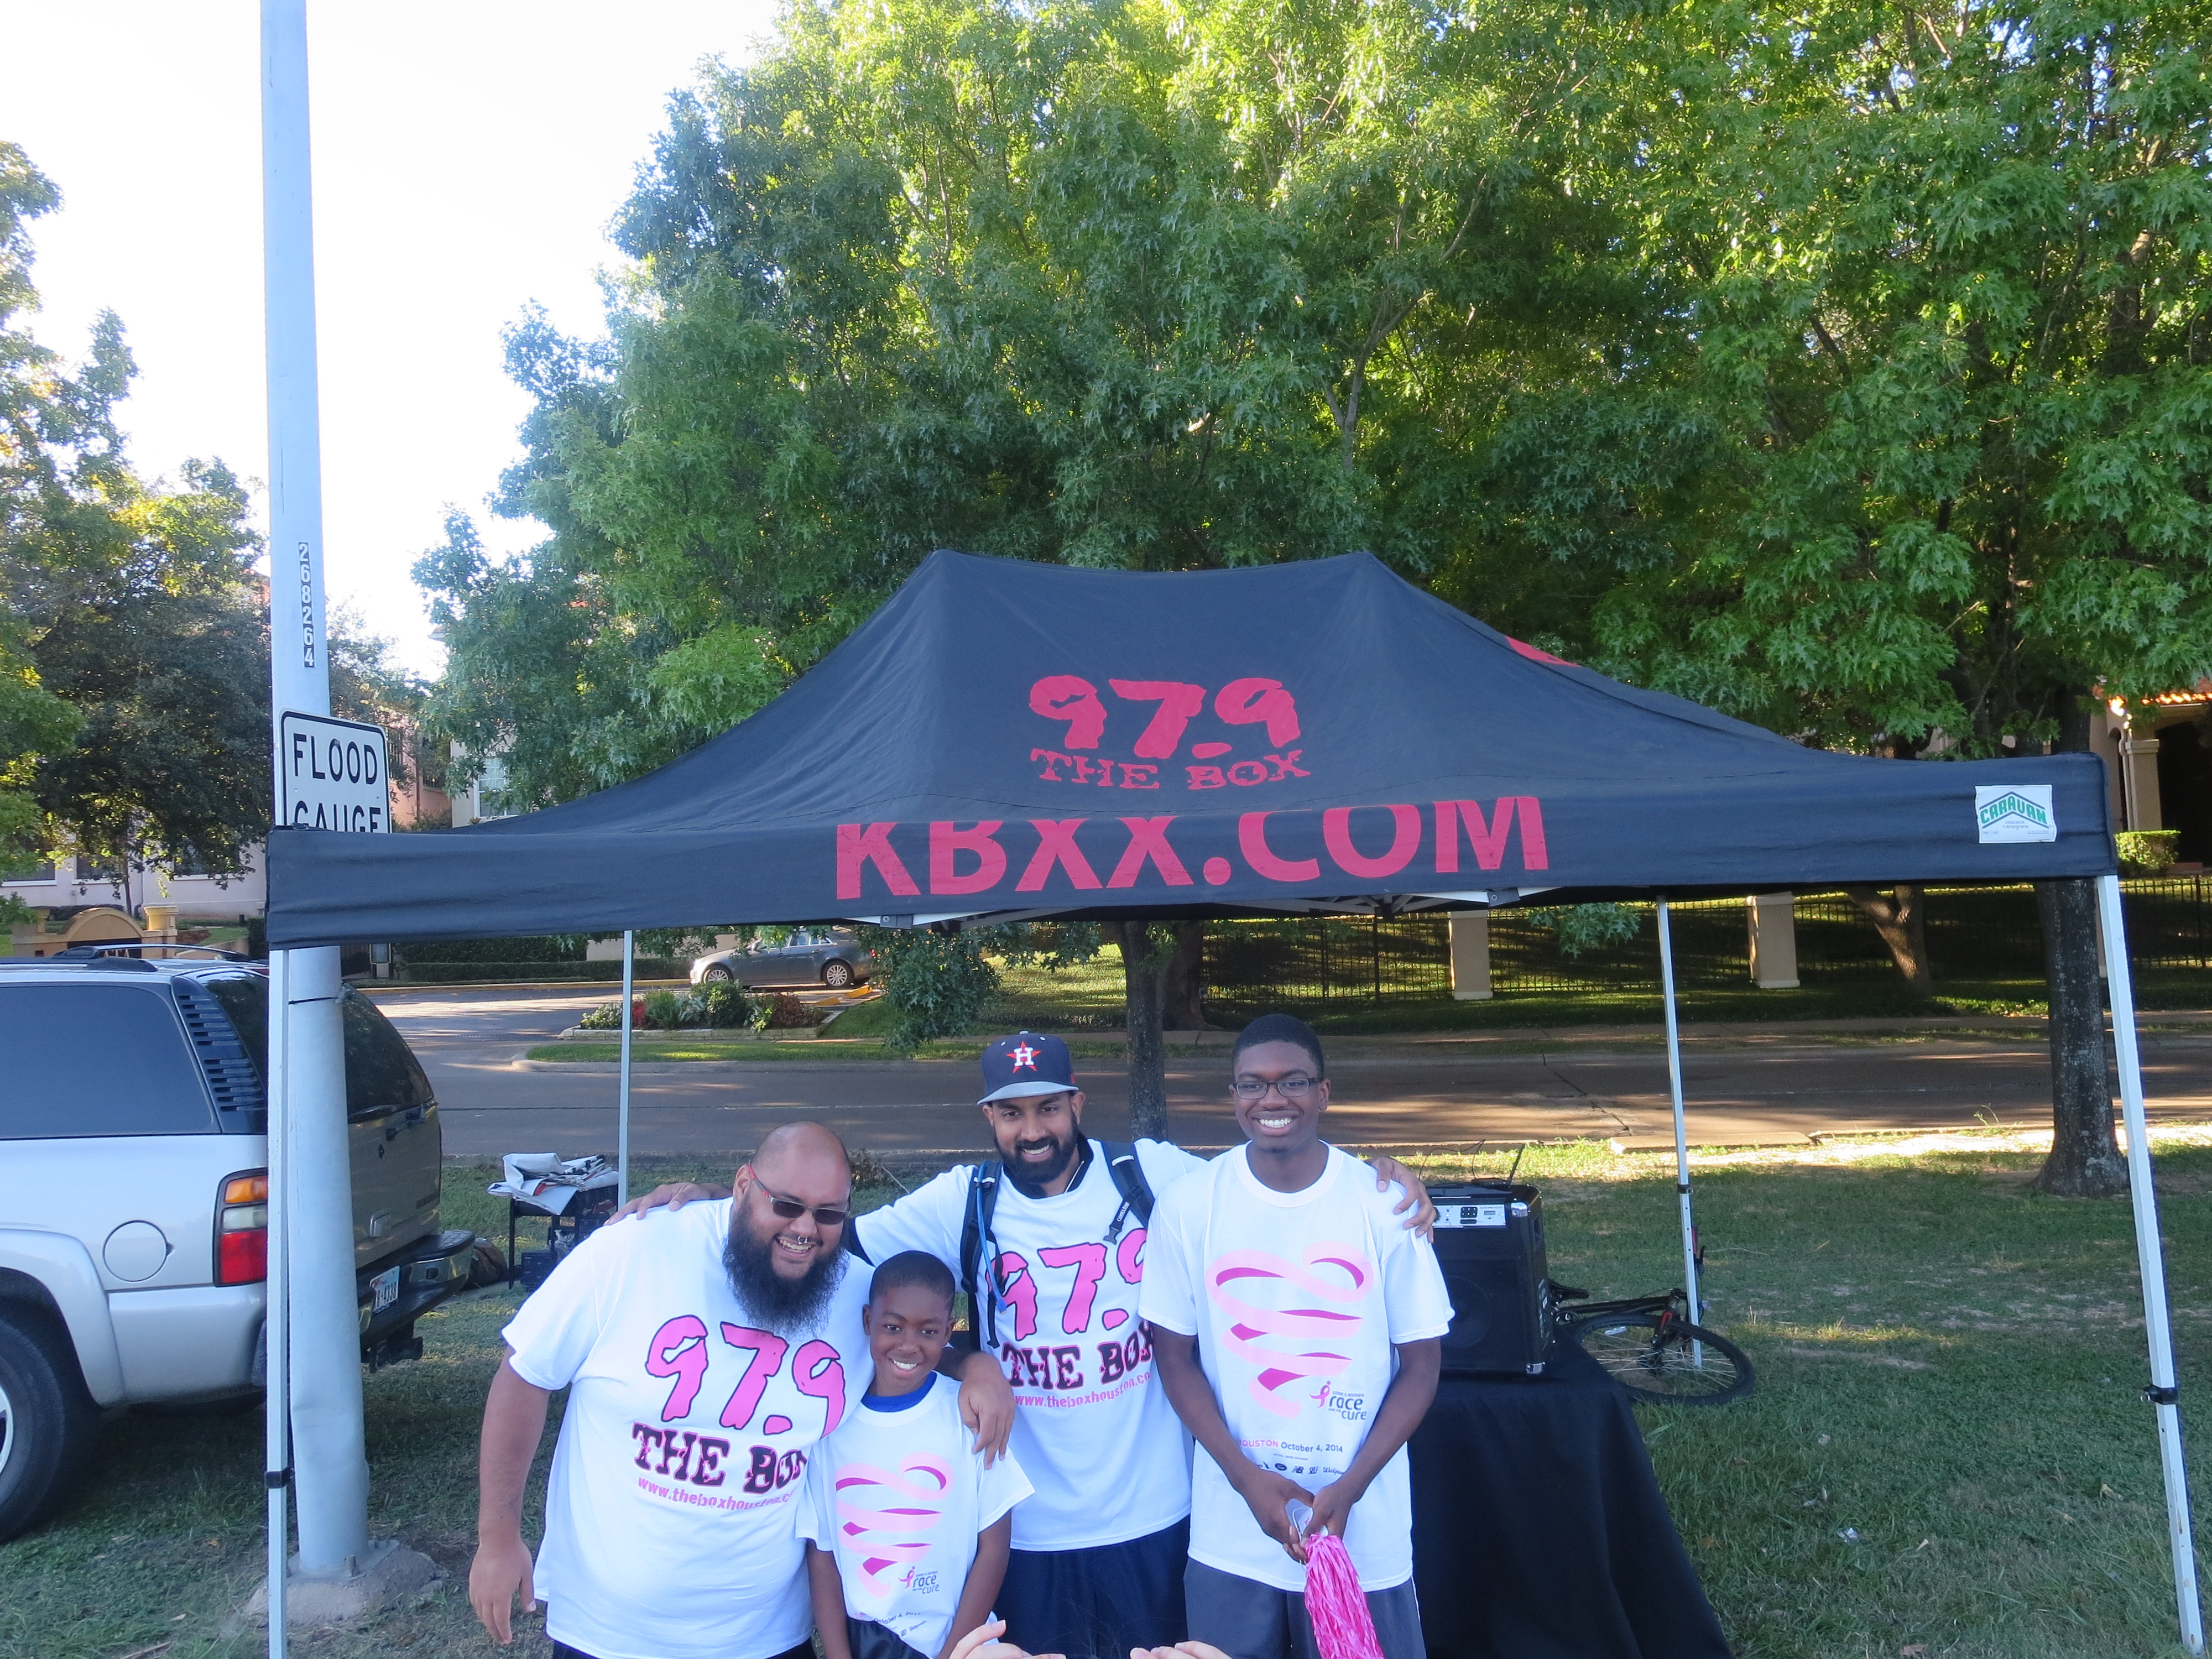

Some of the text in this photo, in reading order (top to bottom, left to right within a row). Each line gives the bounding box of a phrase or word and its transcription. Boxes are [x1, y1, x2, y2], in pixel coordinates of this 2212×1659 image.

[299, 544, 315, 667] 268264
[1029, 675, 1301, 759] 97.9
[293, 733, 378, 785] FLOOD
[1029, 748, 1311, 790] THE BOX
[1980, 795, 2047, 825] CARAVAN
[836, 796, 1548, 900] KBXX.COM
[1014, 1047, 1034, 1067] H
[645, 1314, 846, 1439] 97.9
[1001, 1342, 1084, 1390] THE
[1329, 1395, 1363, 1411] race
[1341, 1410, 1367, 1421] cure
[632, 1422, 731, 1488] THE
[1281, 1442, 1314, 1453] October
[1315, 1444, 1323, 1453] 4,
[1325, 1443, 1343, 1453] 2014
[912, 1574, 937, 1588] race
[922, 1584, 940, 1595] cure
